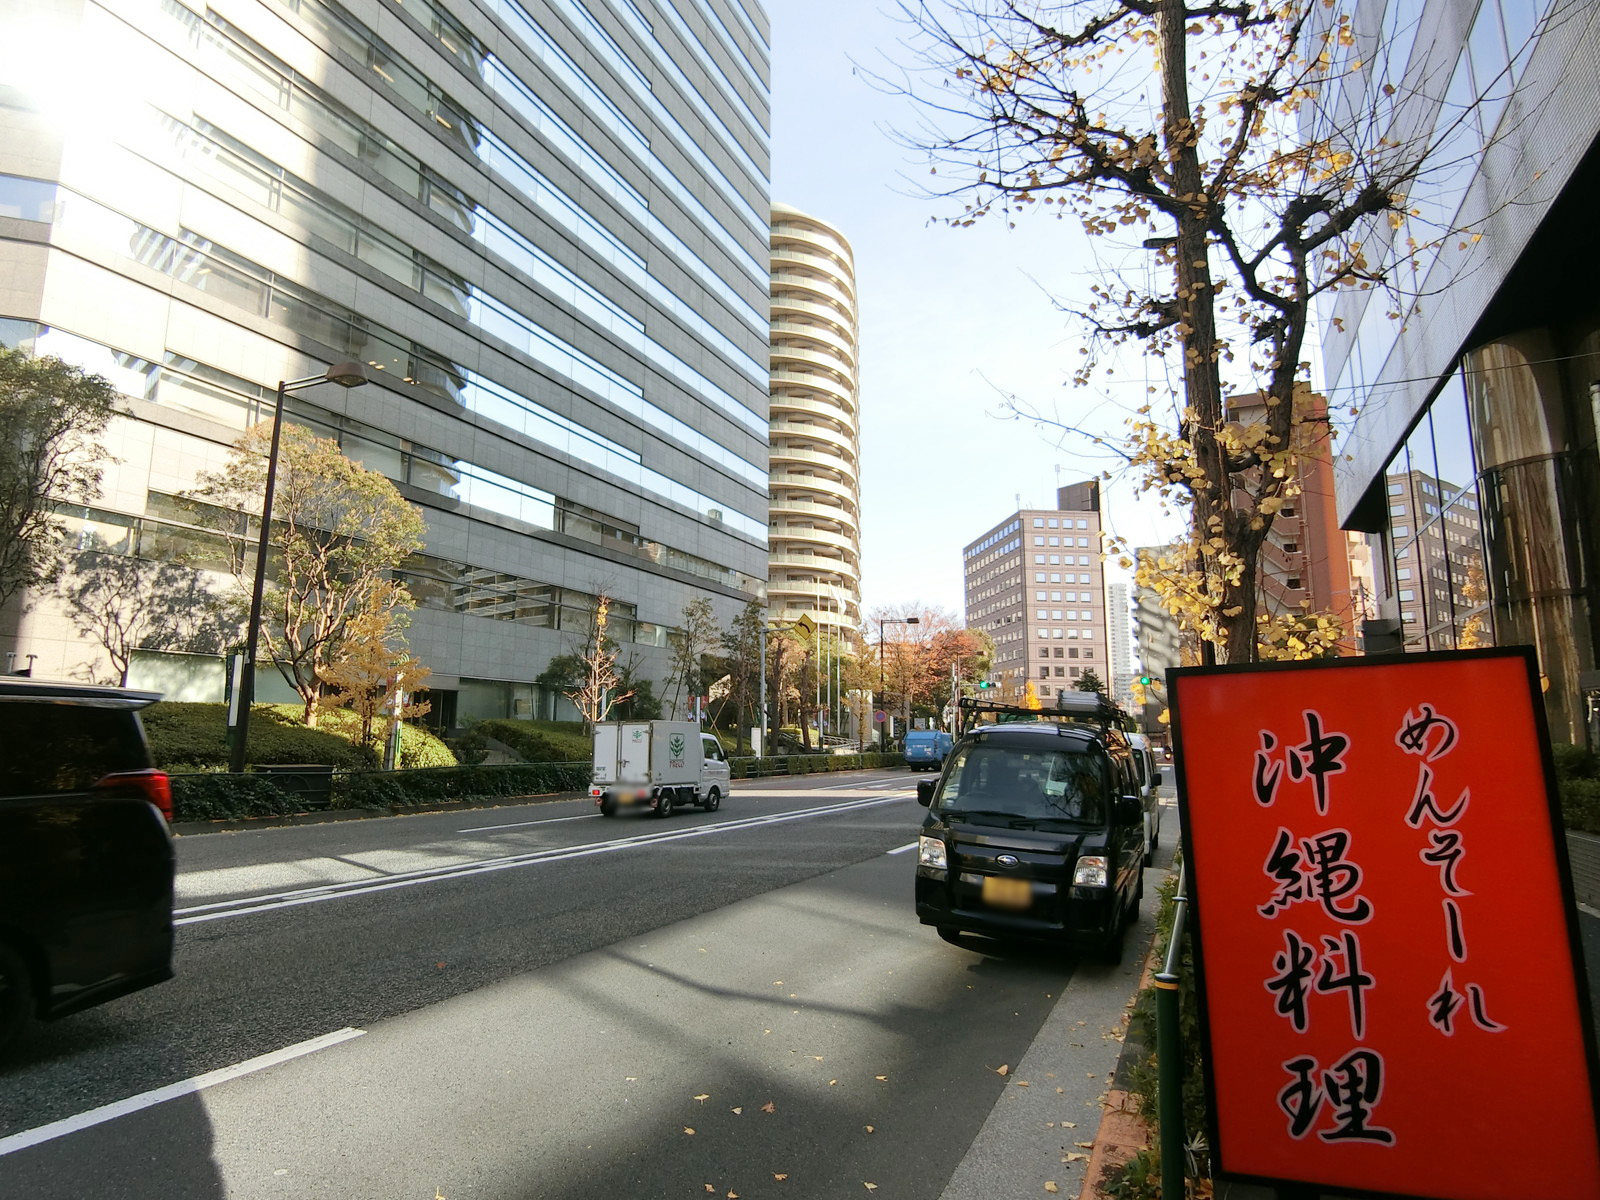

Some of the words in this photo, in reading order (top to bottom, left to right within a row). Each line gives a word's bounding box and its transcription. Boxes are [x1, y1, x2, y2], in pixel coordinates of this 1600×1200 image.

[1252, 709, 1396, 1147] 沖縄料理
[1395, 702, 1508, 1037] めんそーれ
